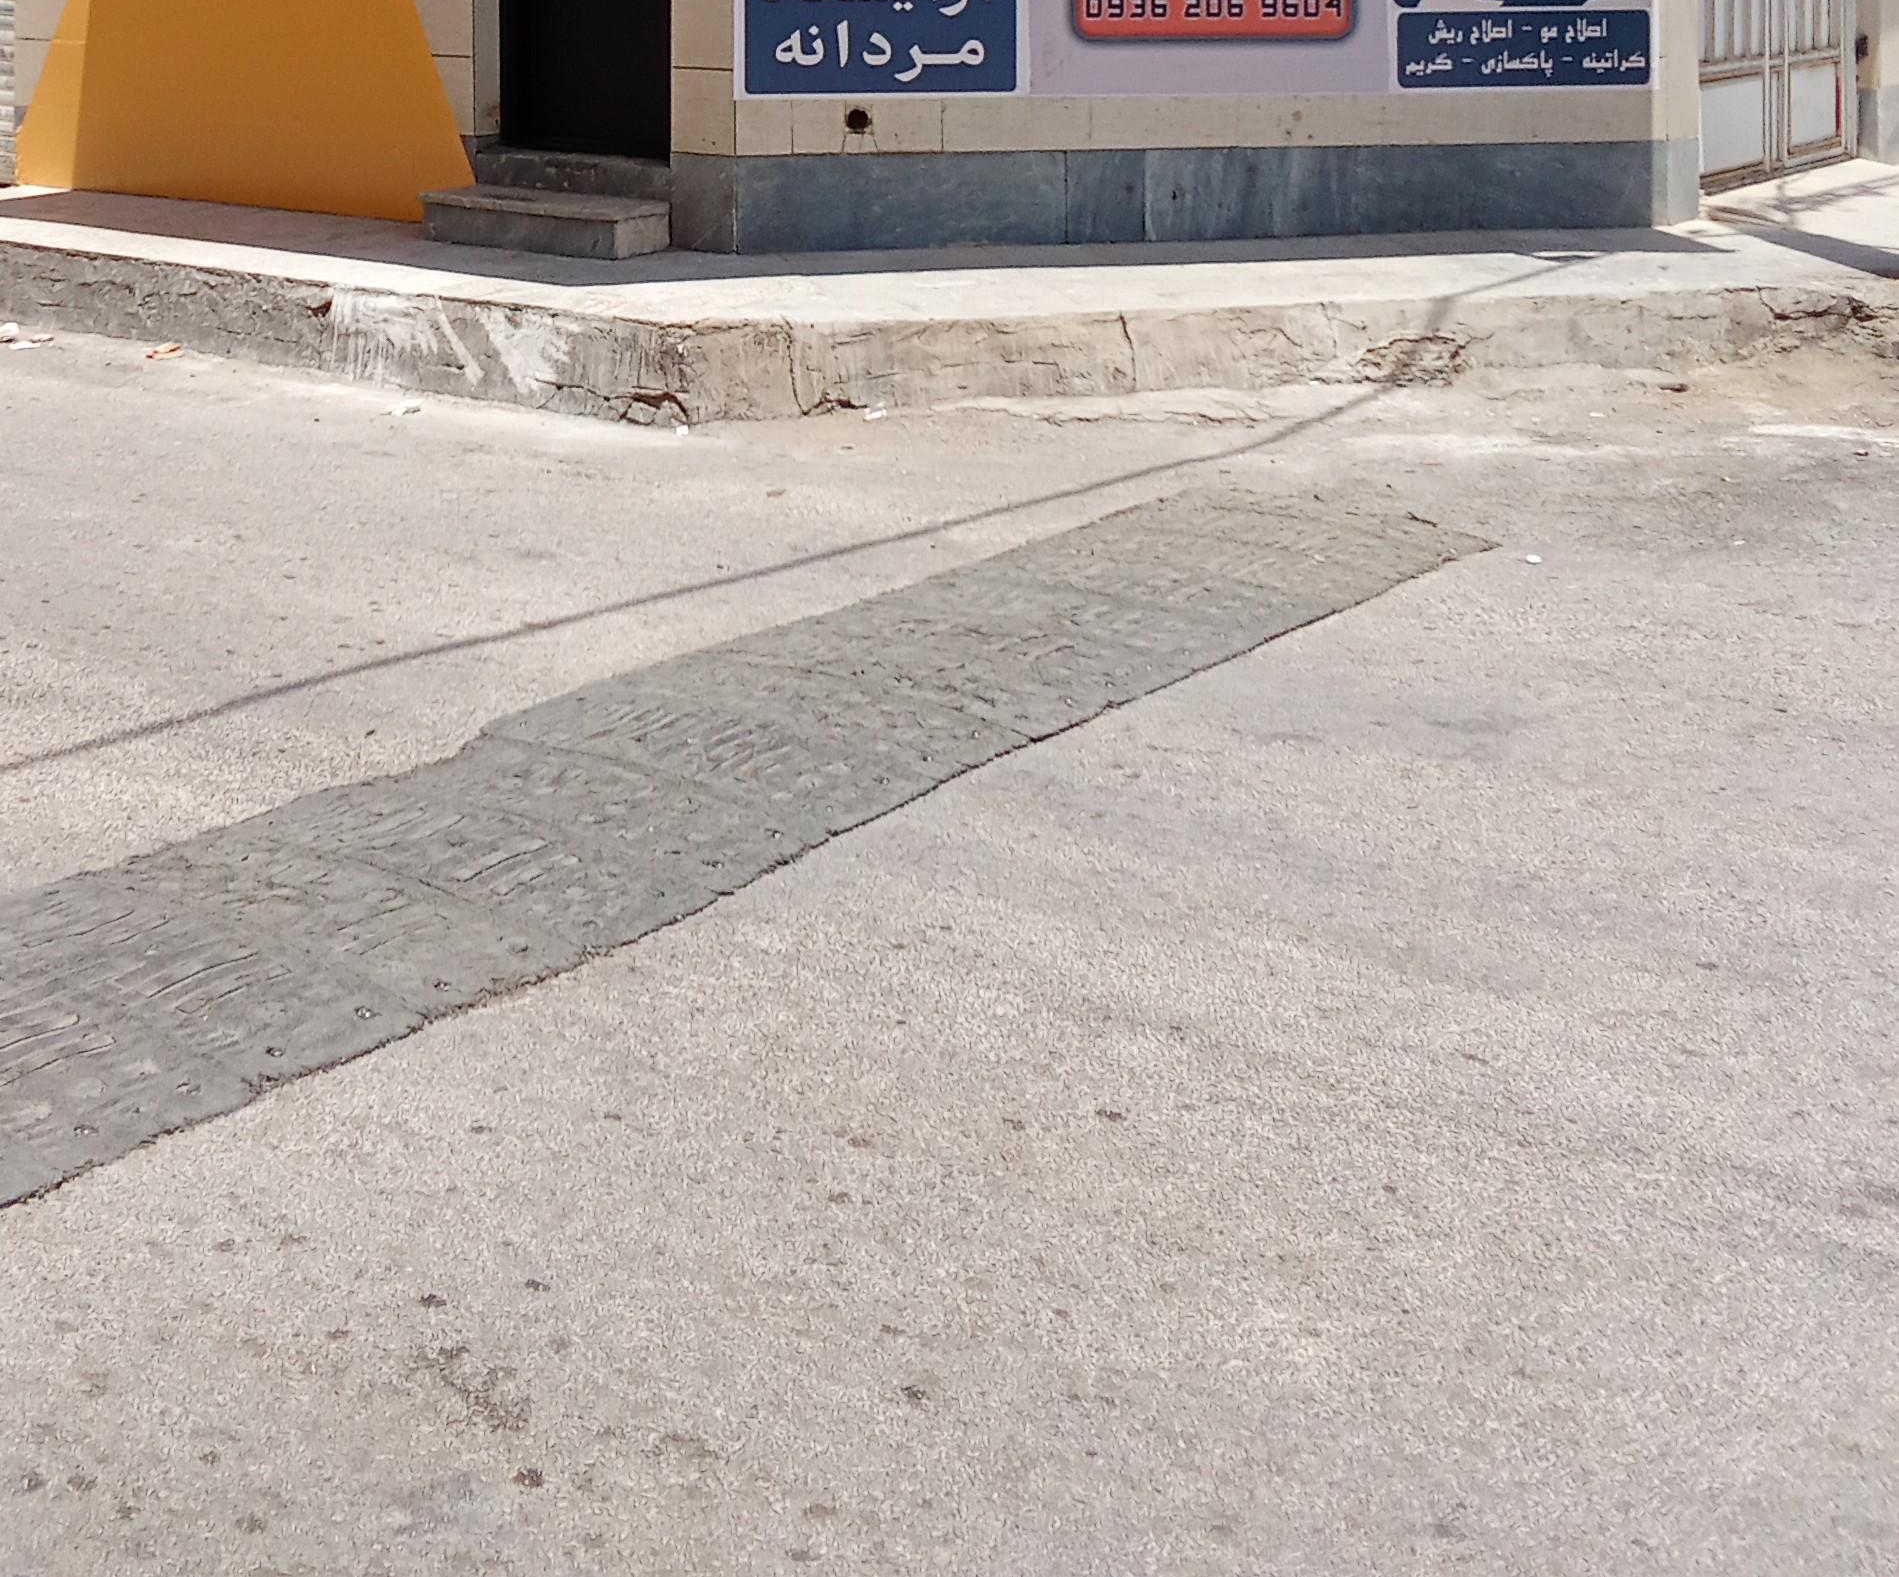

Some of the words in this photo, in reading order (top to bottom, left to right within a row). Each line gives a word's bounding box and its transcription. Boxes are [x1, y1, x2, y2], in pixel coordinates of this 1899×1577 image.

[1428, 19, 1464, 45] ریش
[1469, 18, 1513, 45] اصلاح
[1540, 25, 1558, 44] مو
[1565, 17, 1608, 44] اصلاح
[775, 19, 986, 82] مردانه
[1582, 48, 1646, 74] کراتینه
